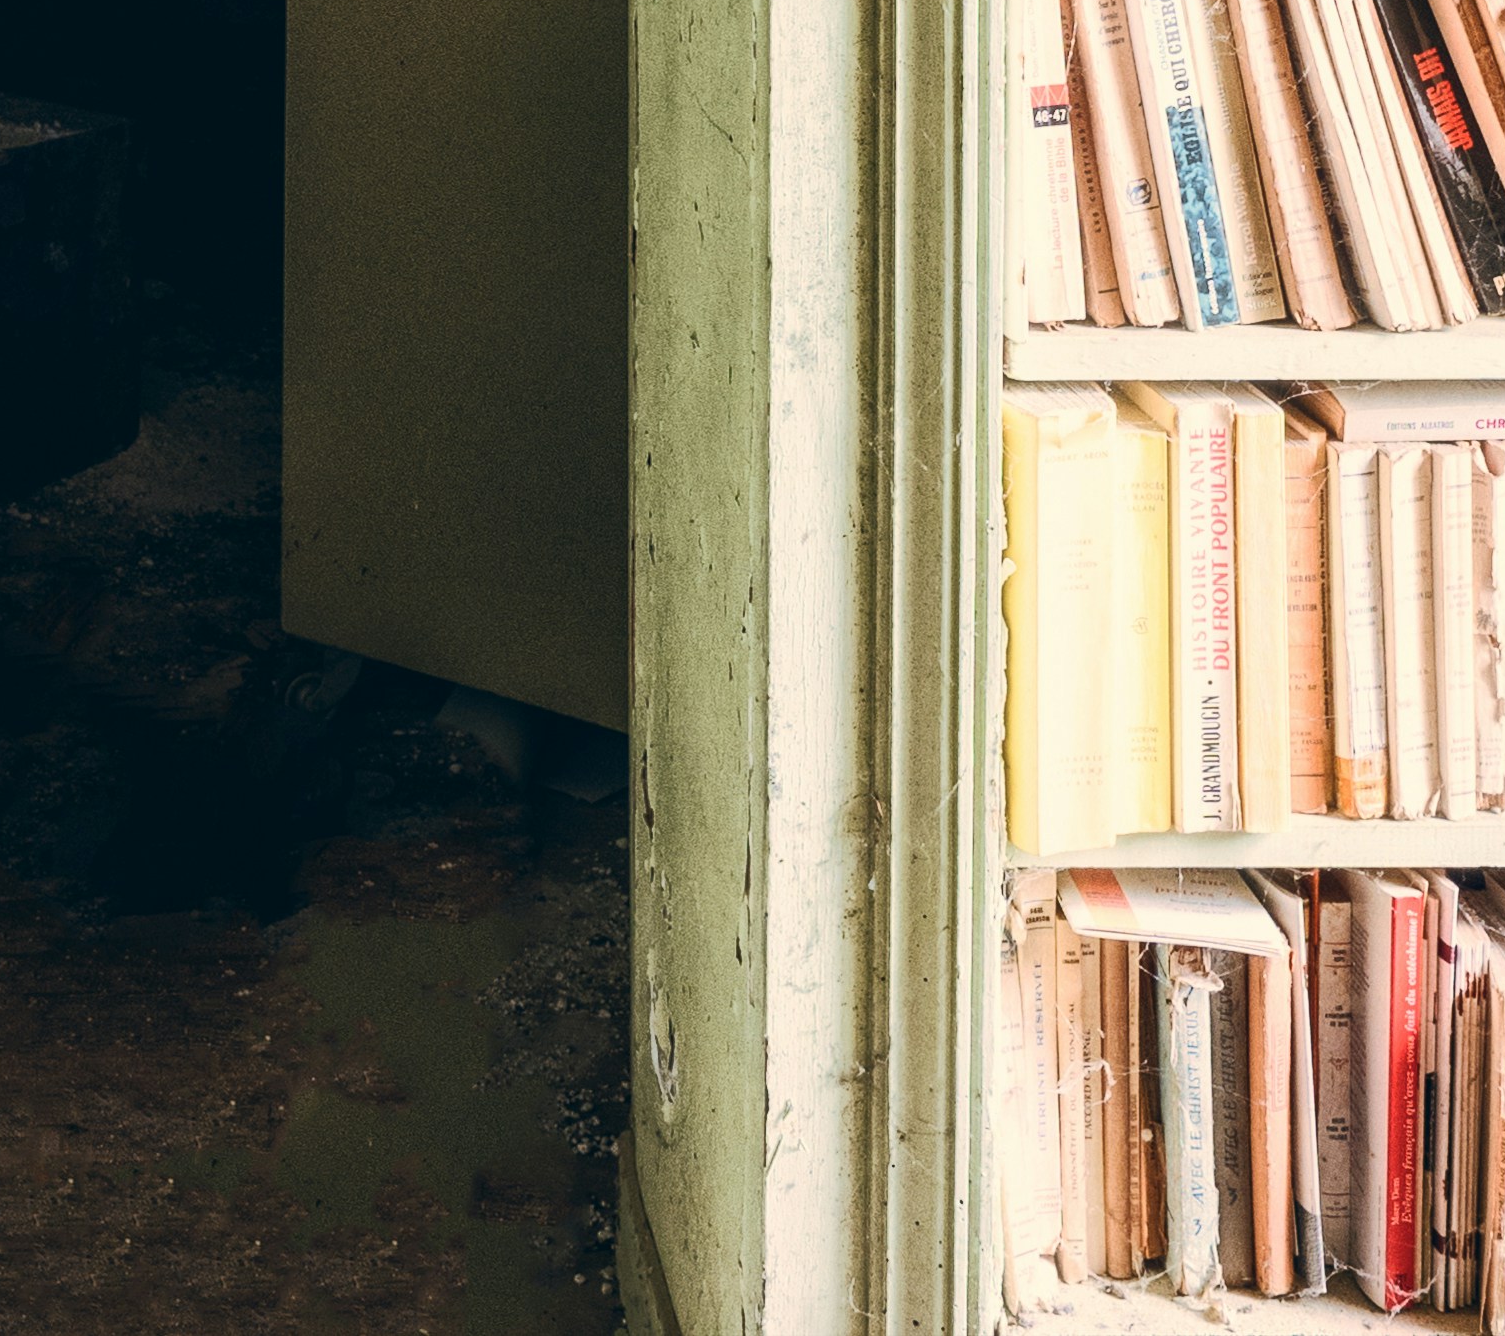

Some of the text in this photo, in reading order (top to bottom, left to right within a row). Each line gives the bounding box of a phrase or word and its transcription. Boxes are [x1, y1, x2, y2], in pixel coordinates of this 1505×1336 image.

[1412, 47, 1474, 150] JAMAIS DIT
[1188, 427, 1208, 671] HISTOIRE VIVANTE
[1208, 427, 1230, 671] DU FRONT POPULAIRE
[1200, 695, 1221, 821] J. GRANDMOUGIN
